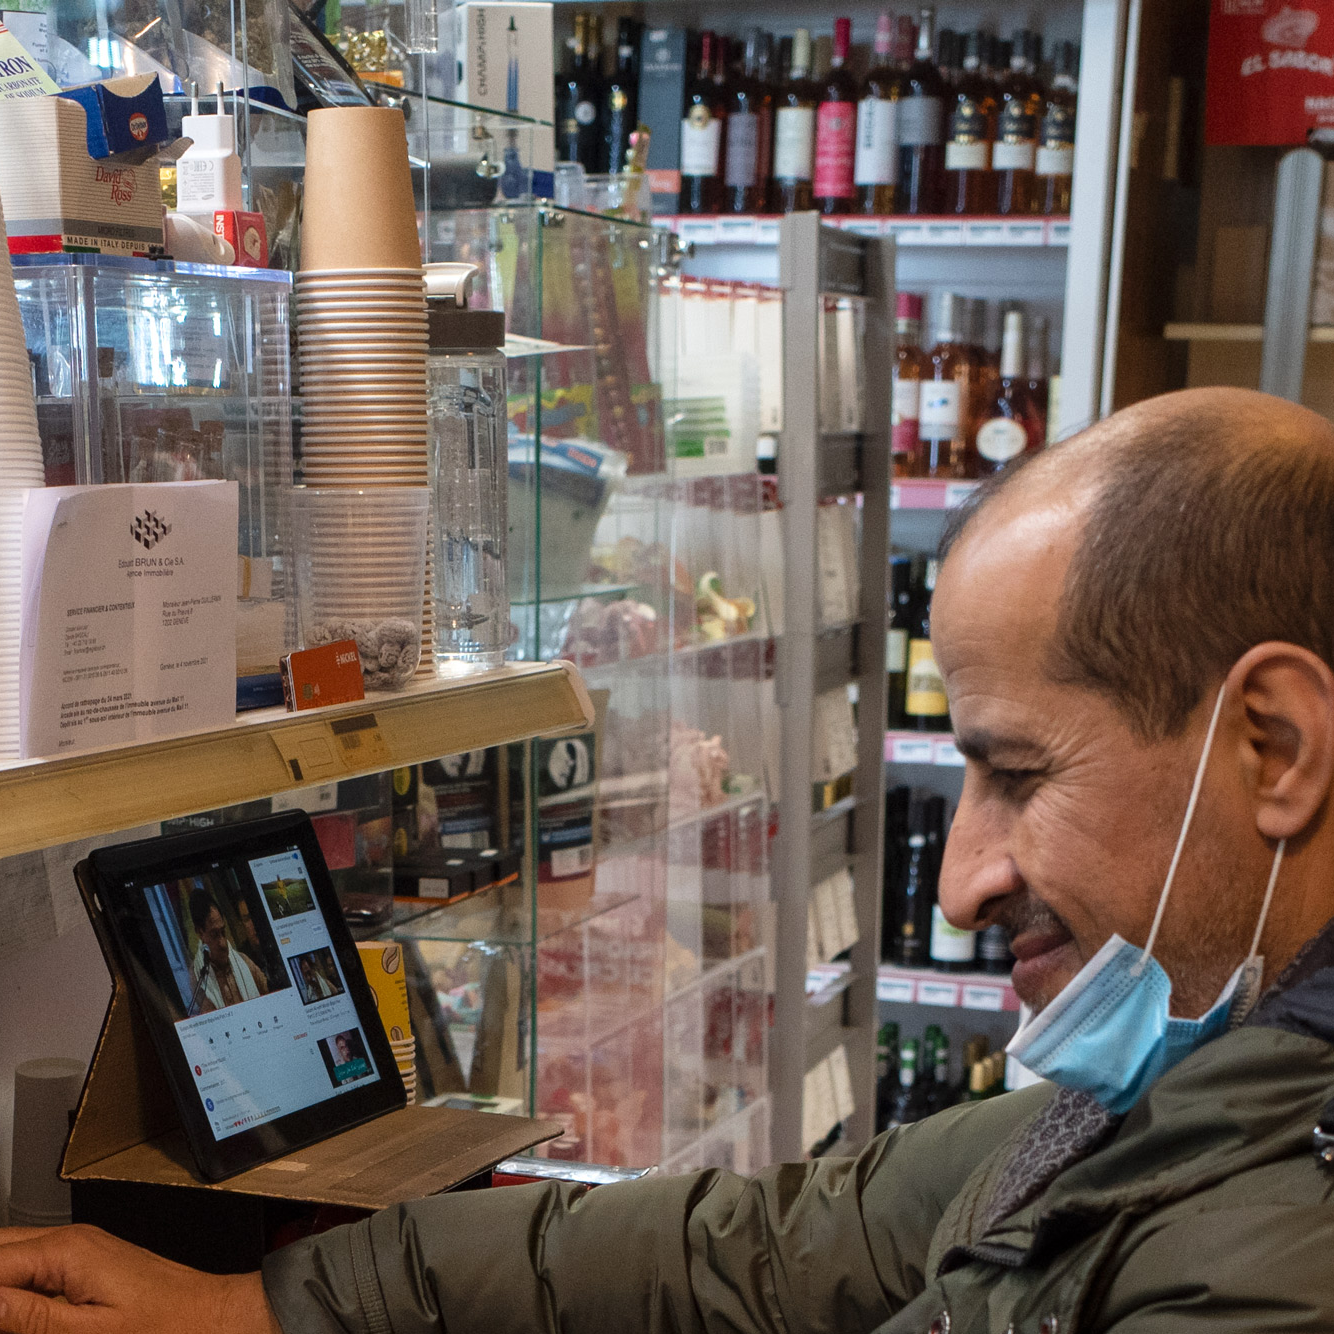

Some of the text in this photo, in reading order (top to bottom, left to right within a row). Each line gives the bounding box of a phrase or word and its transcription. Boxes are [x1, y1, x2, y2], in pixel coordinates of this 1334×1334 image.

[96, 166, 122, 184] David
[110, 184, 133, 206] Ross
[67, 237, 88, 246] MADE
[90, 238, 99, 246] IN
[100, 239, 120, 249] ITALY
[135, 557, 157, 567] BRUN
